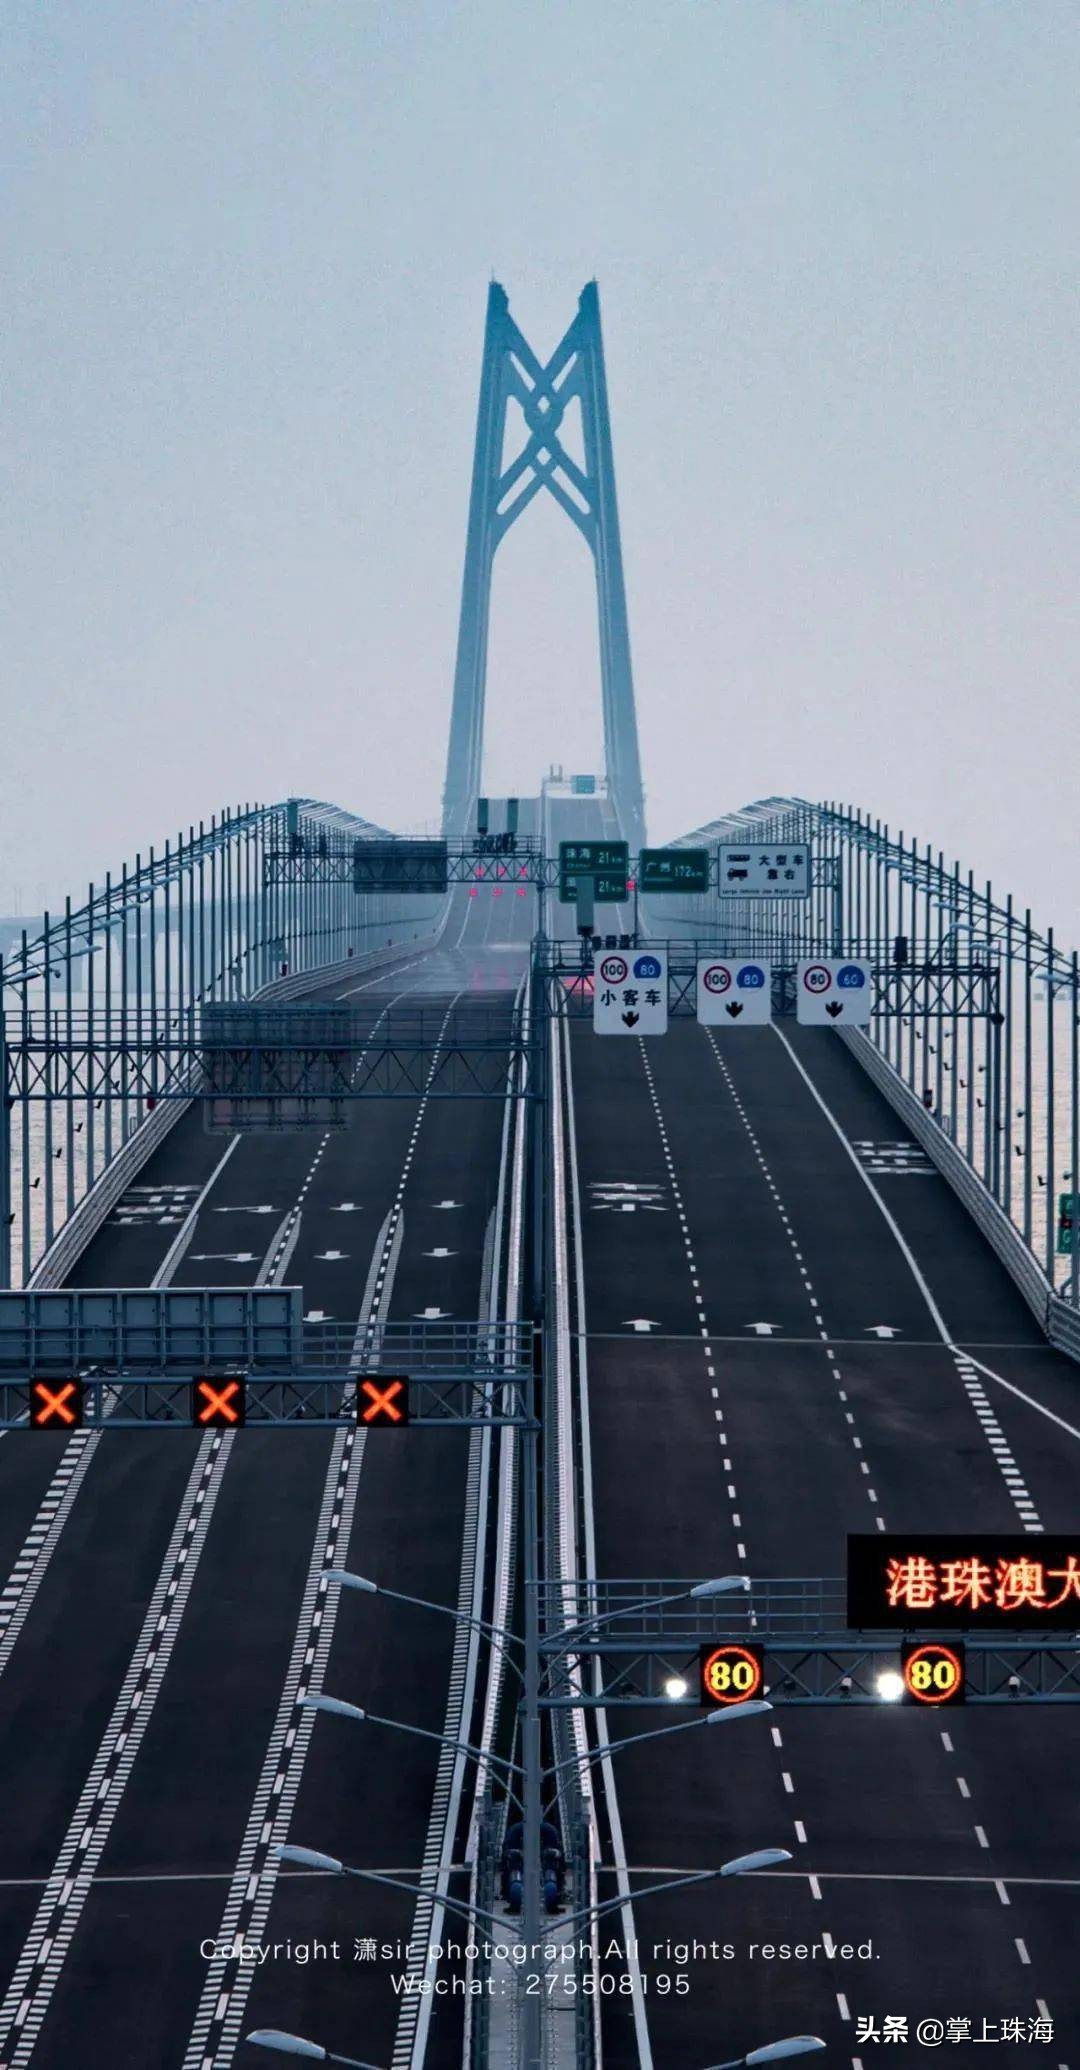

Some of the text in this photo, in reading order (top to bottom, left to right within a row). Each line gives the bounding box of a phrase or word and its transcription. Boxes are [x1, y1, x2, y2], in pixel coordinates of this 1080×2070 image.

[758, 854, 804, 866] 大型车
[767, 868, 796, 880] 靠右
[604, 964, 625, 976] 100
[640, 965, 655, 976] 80
[707, 974, 728, 985] 100
[744, 974, 759, 985] 80
[810, 974, 826, 985] 80
[843, 974, 858, 985] 60
[600, 989, 661, 1007] 小客车
[886, 1556, 1080, 1609] 港珠澳大
[710, 1660, 755, 1691] 80
[910, 1660, 956, 1691] 80
